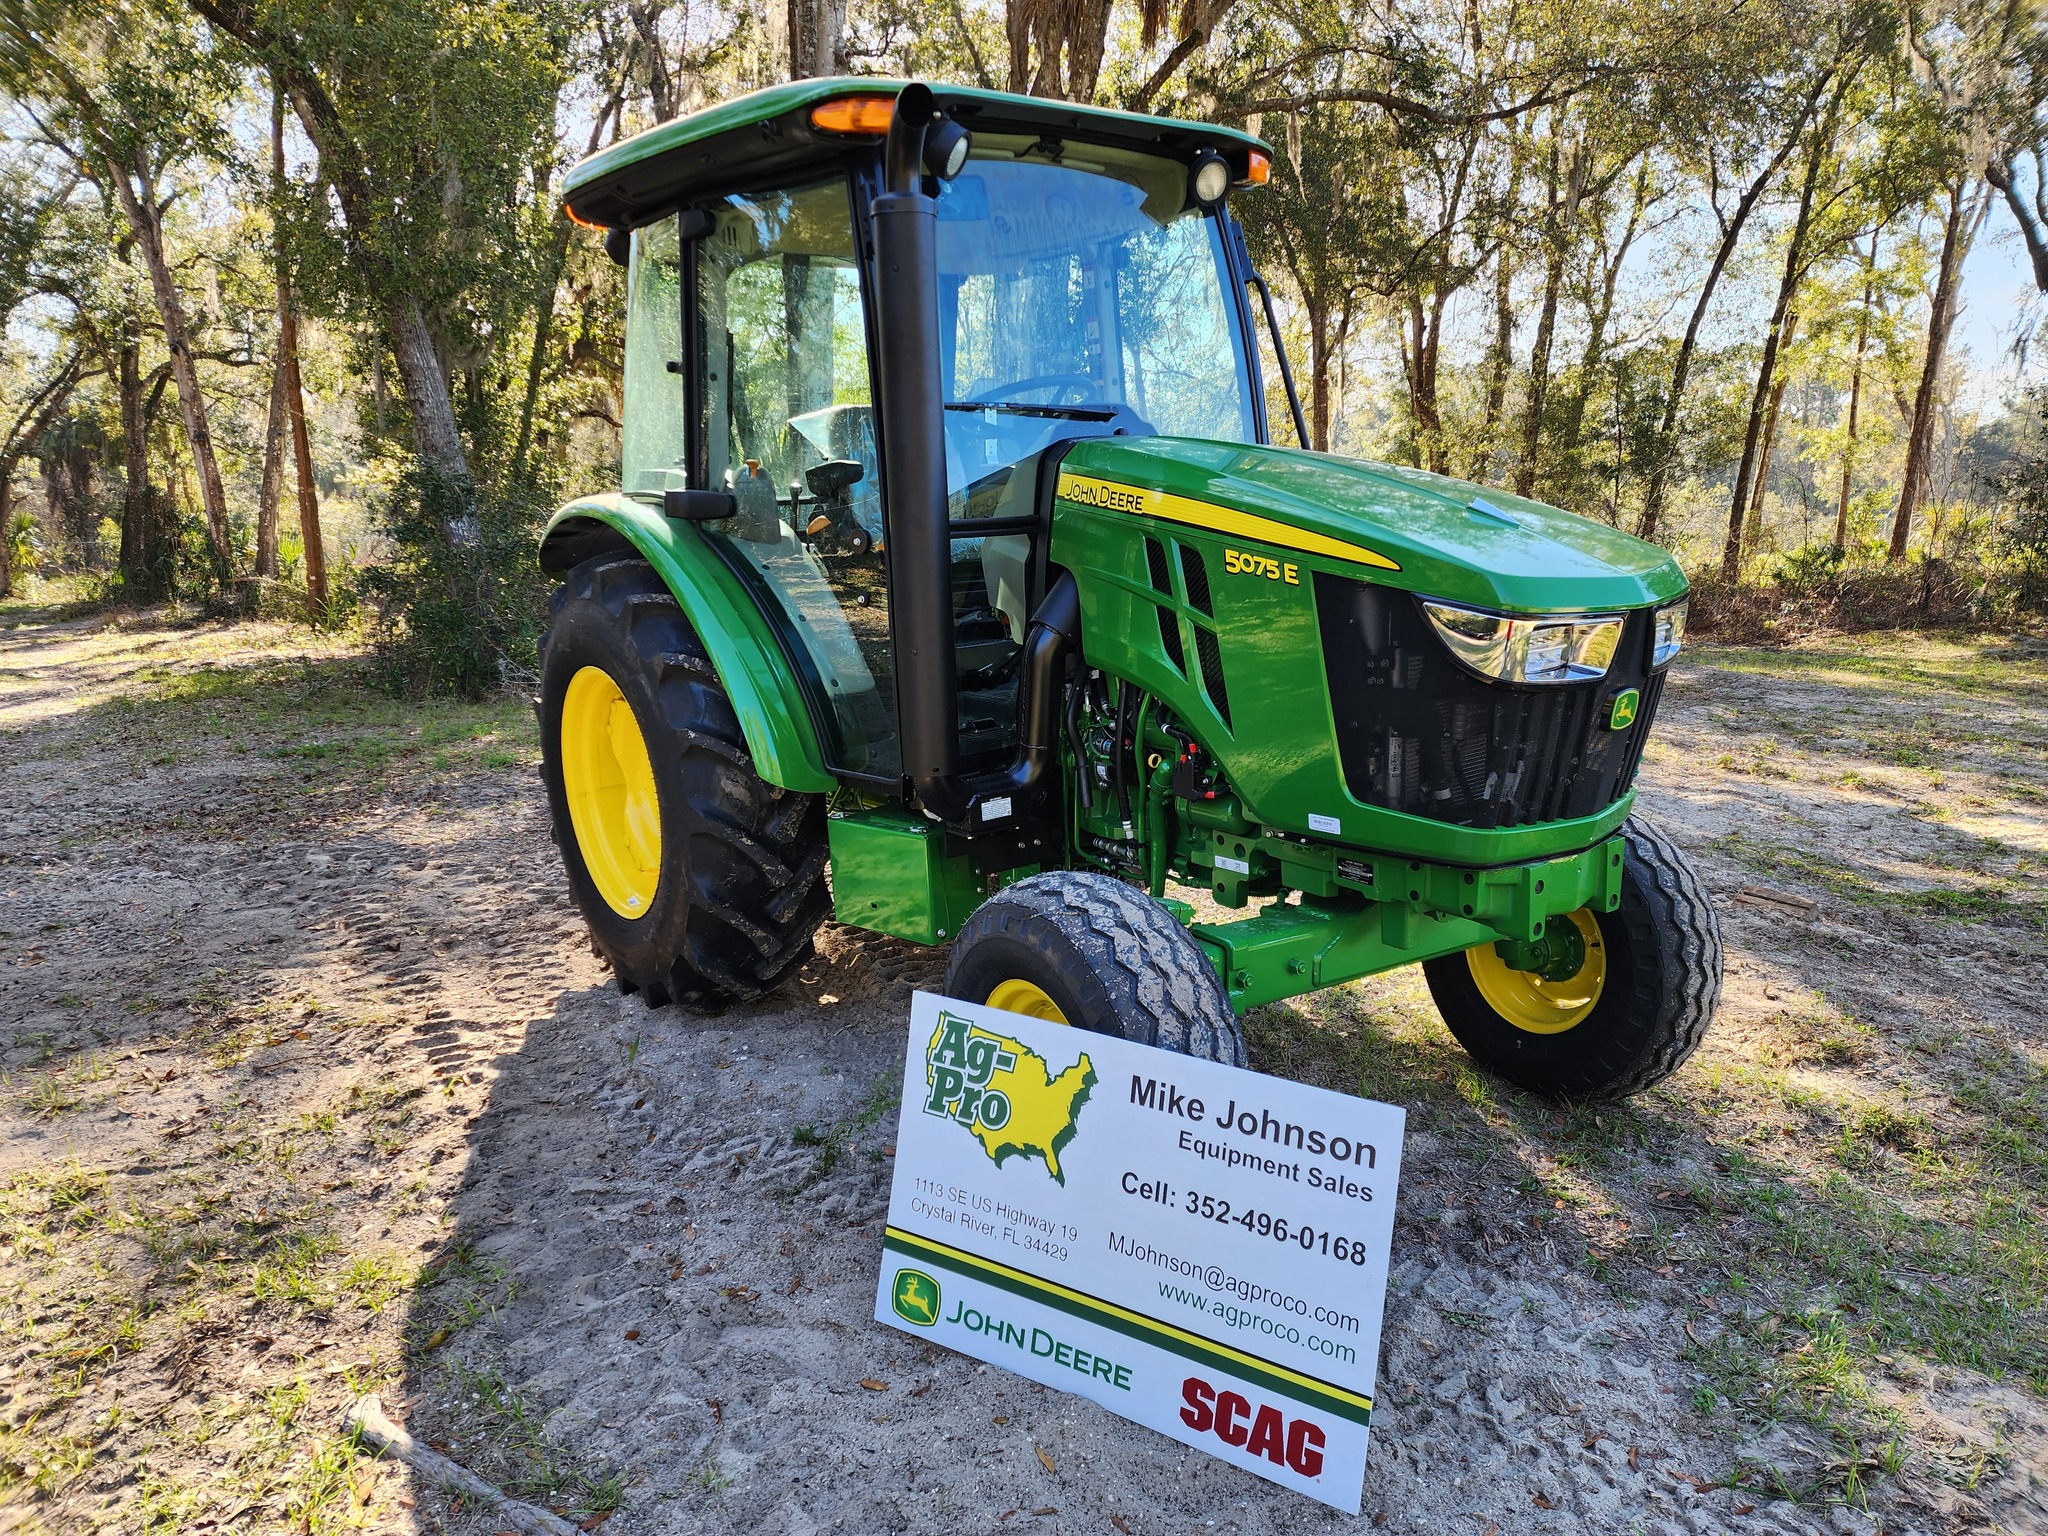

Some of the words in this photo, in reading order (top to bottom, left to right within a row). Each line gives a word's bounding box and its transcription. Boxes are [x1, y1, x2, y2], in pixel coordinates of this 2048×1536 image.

[1066, 480, 1098, 505] JOHN
[1099, 486, 1144, 511] DEERE
[1224, 548, 1280, 581] 5075
[1283, 563, 1299, 586] E
[930, 1016, 1017, 1085] Ag-
[923, 1067, 1011, 1131] Pro
[1129, 1074, 1205, 1122] Mike
[1215, 1100, 1377, 1169] Johnson
[1178, 1130, 1300, 1182] Equipment
[1307, 1167, 1374, 1202] Sales
[911, 1198, 956, 1225] Crystal
[960, 1212, 998, 1240] River,
[1002, 1226, 1020, 1245] FL
[1023, 1234, 1069, 1262] 34429
[914, 1177, 944, 1198] 1113
[947, 1187, 967, 1204] SE
[971, 1192, 993, 1213] US
[997, 1202, 1056, 1237] Highway
[1061, 1225, 1079, 1243] 19
[1121, 1171, 1177, 1208] Cell:
[1185, 1191, 1367, 1266] 352-496-0168
[1108, 1232, 1360, 1334] MJohnson@agproco.com
[946, 1300, 1026, 1350] JOHN
[1030, 1328, 1133, 1391] DEERE
[1158, 1281, 1357, 1365] www.agproco.com
[1179, 1377, 1326, 1478] SCAG
